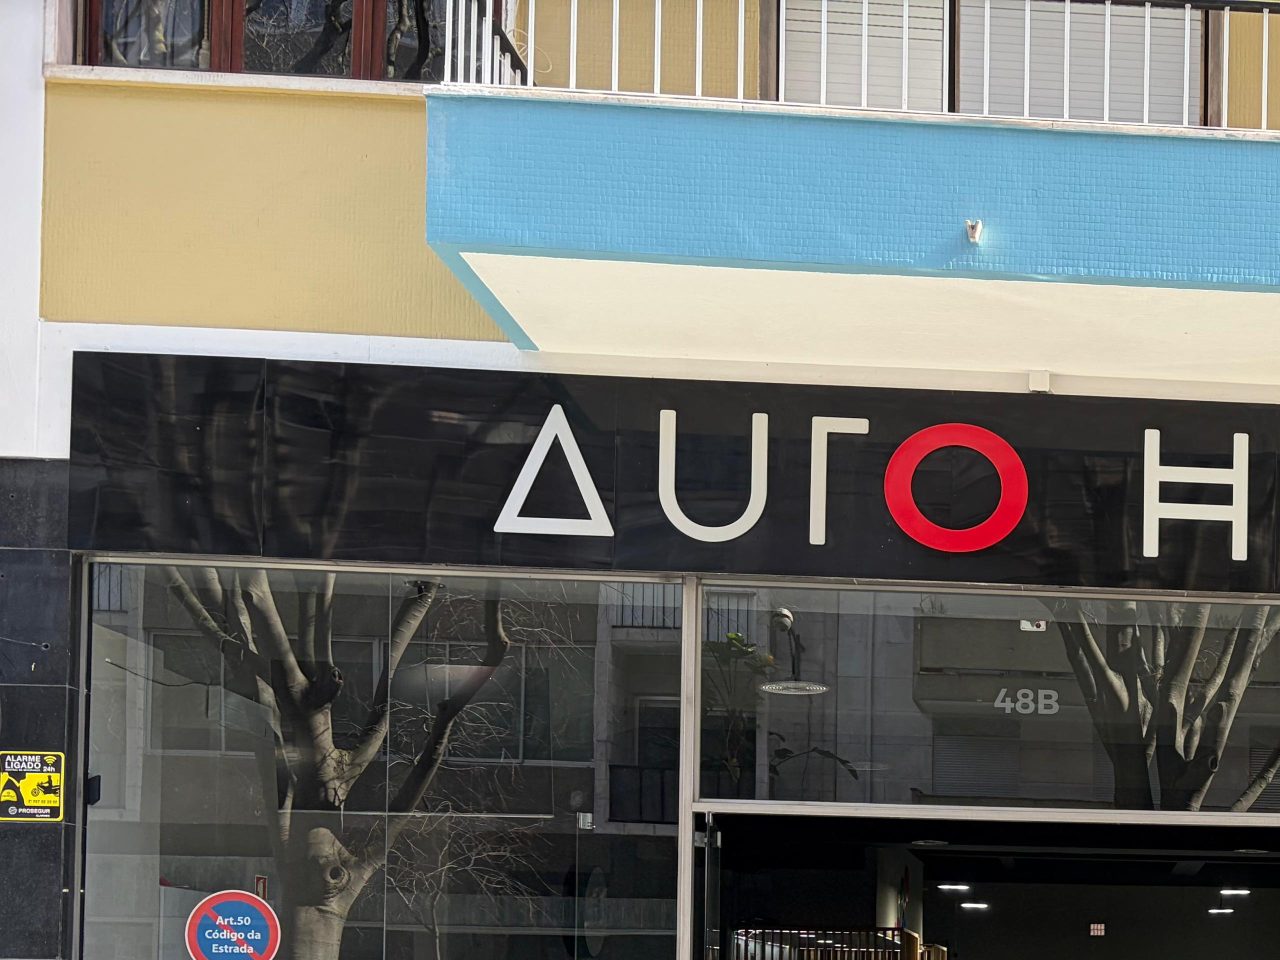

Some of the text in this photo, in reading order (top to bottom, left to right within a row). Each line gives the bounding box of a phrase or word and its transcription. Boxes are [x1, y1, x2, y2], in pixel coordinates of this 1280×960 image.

[494, 404, 1029, 553] AUTO
[993, 688, 1060, 715] 48B
[5, 761, 41, 769] LIGADO
[216, 915, 251, 926] Art.50
[205, 929, 261, 942] Código da
[212, 943, 254, 954] Estrada
